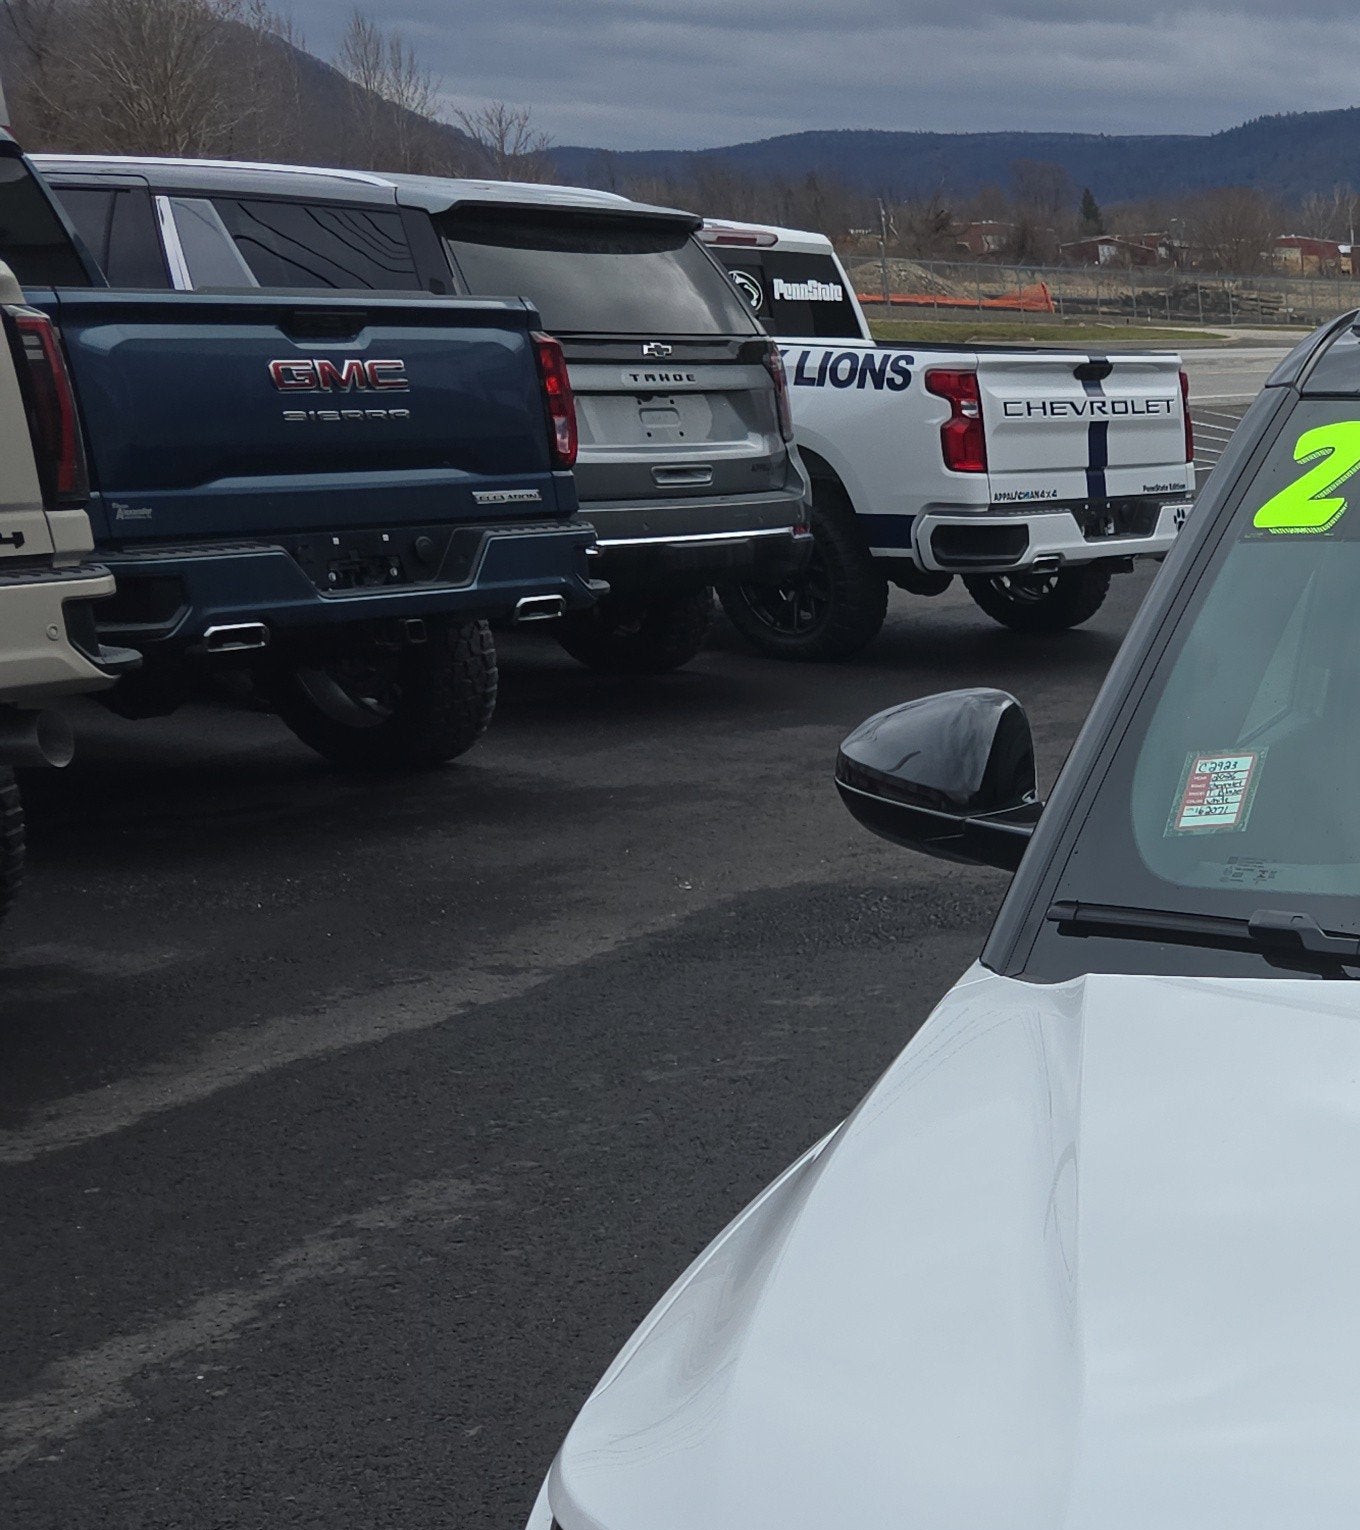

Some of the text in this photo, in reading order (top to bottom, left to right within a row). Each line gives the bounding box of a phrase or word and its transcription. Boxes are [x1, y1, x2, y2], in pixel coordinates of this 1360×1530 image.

[268, 359, 411, 393] GMC
[629, 373, 696, 382] TAHOE
[793, 349, 915, 391] LIONS
[283, 408, 410, 422] SIERRA
[1003, 399, 1175, 417] CHEVROLET
